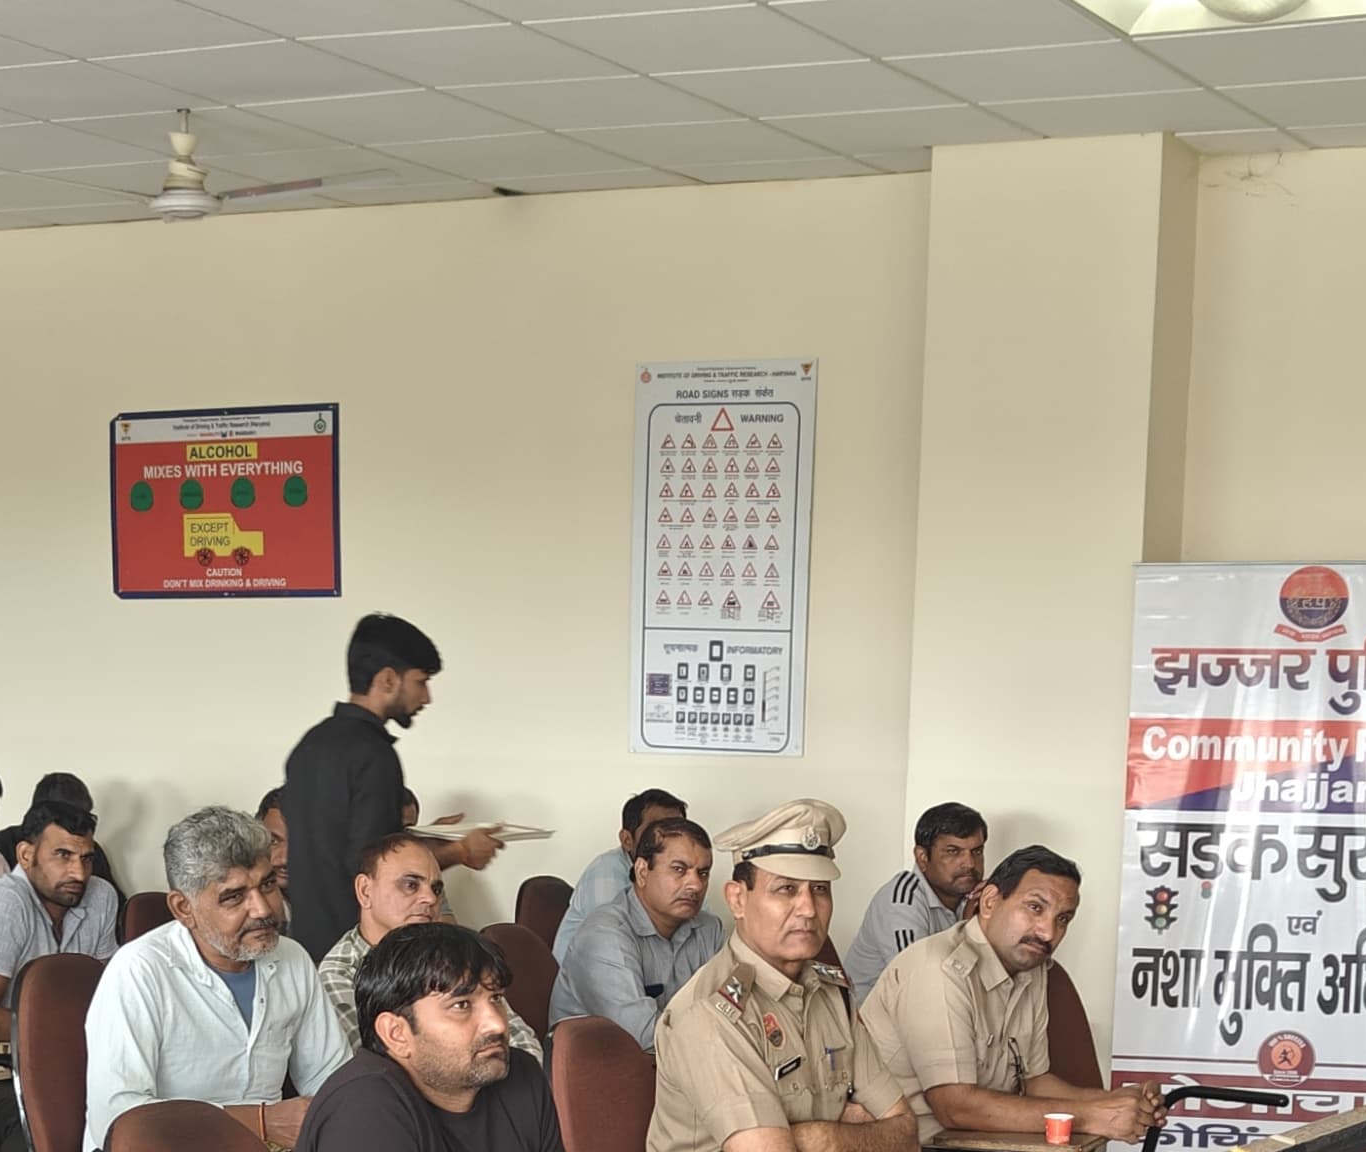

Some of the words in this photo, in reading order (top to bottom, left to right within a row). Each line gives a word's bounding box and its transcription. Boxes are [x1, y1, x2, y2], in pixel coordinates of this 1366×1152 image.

[676, 390, 700, 399] ROAD
[702, 389, 729, 399] SIGNS
[740, 414, 784, 424] WARNING
[189, 444, 252, 459] ALCOHOL
[143, 465, 182, 479] MIXES
[185, 463, 217, 477] WITH
[220, 460, 304, 477] EVERYTHING
[190, 522, 229, 534] EXCEPT
[190, 535, 231, 547] DRIVING
[206, 568, 243, 577] CAUTION
[163, 579, 187, 588] DON'T
[189, 579, 204, 588] MIX
[205, 578, 244, 588] DRINKING
[245, 579, 251, 587] &
[252, 578, 286, 587] DRIVING
[726, 645, 783, 655] INFORMATORY
[1151, 647, 1317, 697] झज्जर
[1142, 726, 1349, 771] Community
[1137, 822, 1289, 884] सड़क
[1287, 910, 1323, 936] एवं
[1131, 948, 1204, 1009] नशा
[1212, 922, 1311, 1047] मुक्ति
